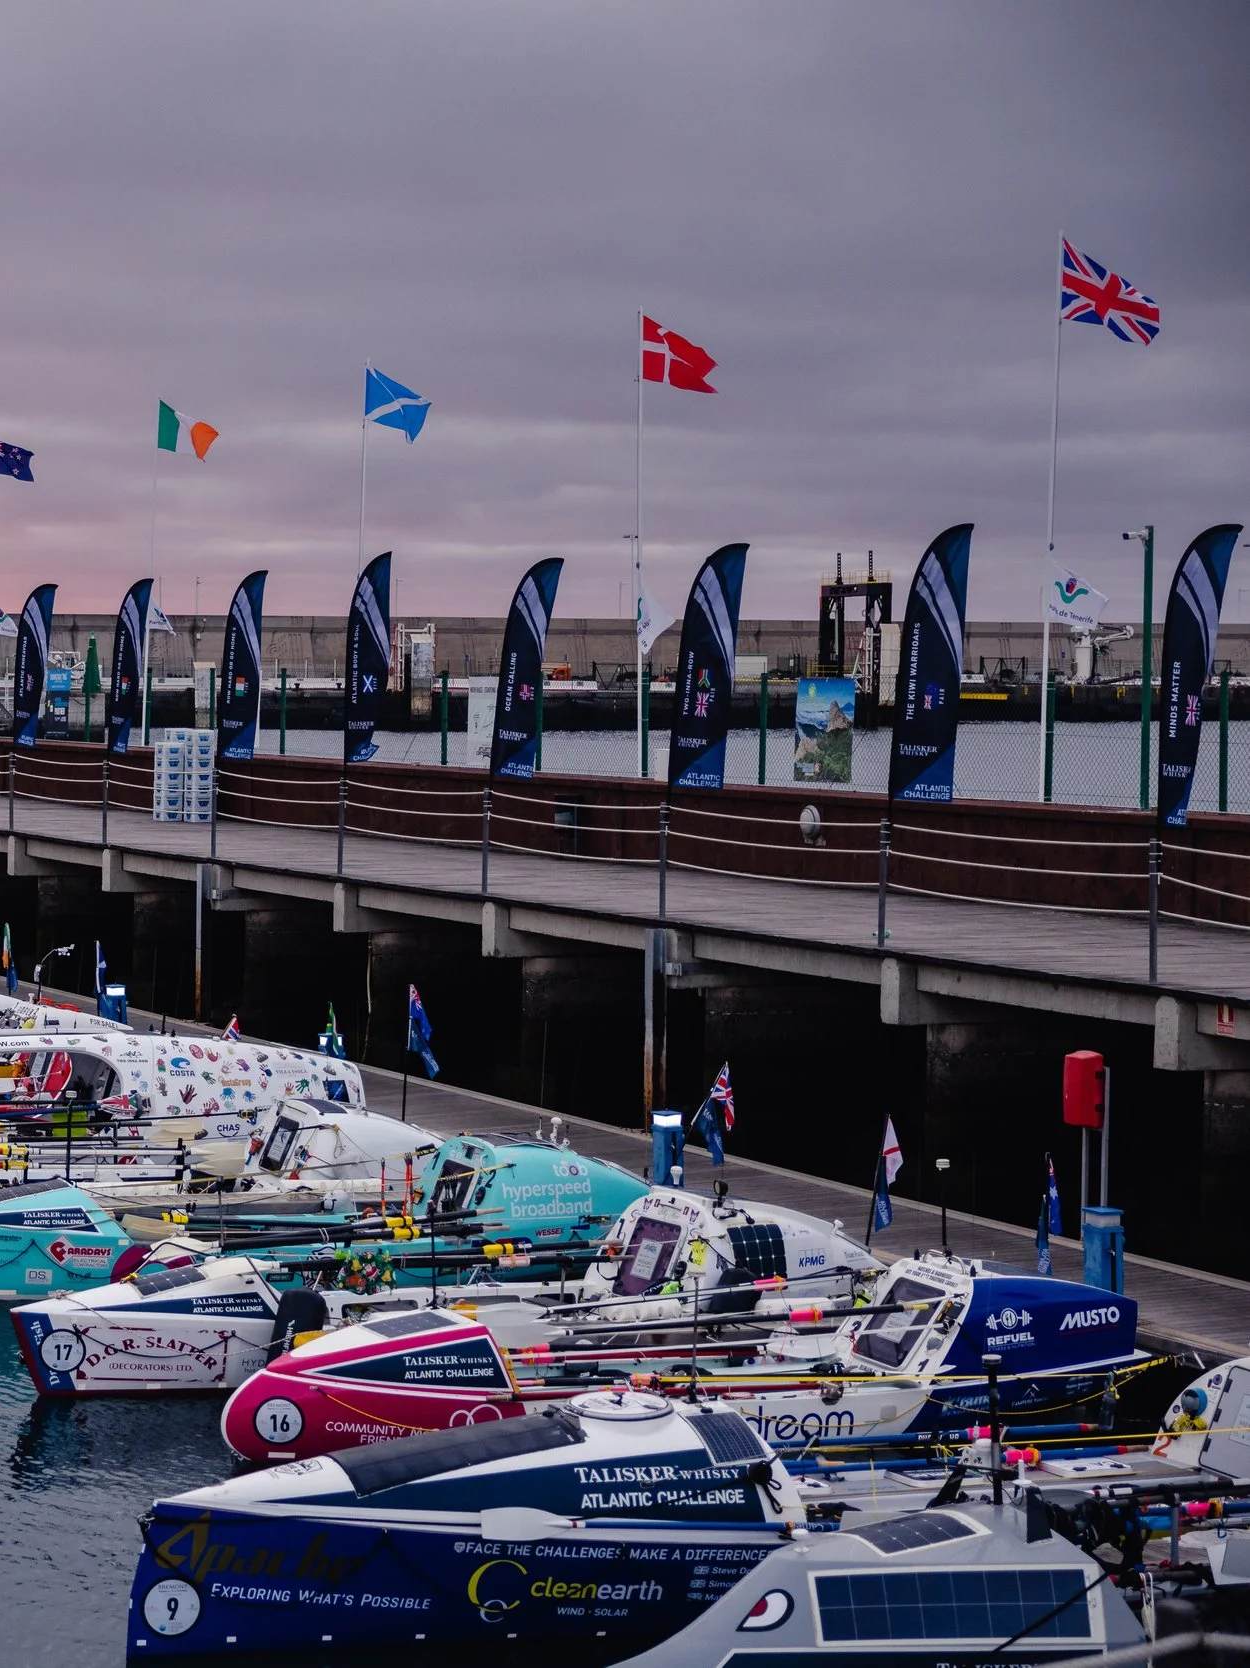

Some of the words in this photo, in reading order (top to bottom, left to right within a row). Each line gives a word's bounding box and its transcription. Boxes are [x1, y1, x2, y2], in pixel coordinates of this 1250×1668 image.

[1070, 612, 1094, 624] Tenerife
[910, 622, 921, 677] WARRIOARS
[508, 652, 517, 684] CALLING
[682, 650, 694, 716] TWO-INNA-ROW
[1172, 661, 1181, 700] MATTER
[908, 679, 916, 700] KIWI
[505, 686, 513, 712] OCEAN
[906, 703, 914, 720] THE
[1168, 704, 1178, 738] MINDS
[900, 744, 938, 752] TALISKER
[679, 778, 720, 788] CHALLENGE
[686, 772, 720, 781] ATLANTIC
[904, 790, 950, 800] CHALLENGE
[914, 783, 950, 792] ATLANTIC
[90, 1018, 100, 1026] FOR
[170, 1069, 196, 1077] COSTA
[216, 1124, 240, 1132] CHAS
[552, 1160, 588, 1177] toob
[484, 1173, 494, 1188] 2
[502, 1178, 592, 1200] hyperspeed
[510, 1198, 592, 1218] broadband
[534, 1226, 565, 1237] WESSEX
[799, 1254, 826, 1268] KPMG
[191, 1297, 235, 1305] TALISKER
[193, 1306, 224, 1314] ATLANTIC
[1060, 1306, 1120, 1331] MUSTO
[987, 1332, 1034, 1346] REFUEL
[54, 1344, 72, 1361] 17
[146, 1336, 218, 1370] SLATTER
[402, 1354, 458, 1366] TALISKER
[460, 1356, 493, 1364] WHISKY
[108, 1362, 174, 1372] (DECORATORS)
[176, 1363, 194, 1372] LTD.
[918, 1358, 930, 1372] 1
[404, 1369, 444, 1380] ATLANTIC
[446, 1368, 494, 1378] CHALLENGE
[270, 1414, 290, 1433] 16
[326, 1422, 406, 1436] COMMUNITY
[746, 1406, 854, 1440] dream
[1152, 1434, 1172, 1458] 2
[574, 1466, 676, 1484] TALISKER
[680, 1468, 740, 1481] WHISKY
[581, 1490, 653, 1510] ATLANTIC
[657, 1488, 746, 1506] CHALLENGE
[466, 1542, 501, 1555] FACE
[506, 1544, 532, 1556] THE
[629, 1548, 668, 1560] MAKE
[672, 1549, 681, 1560] A
[712, 1566, 737, 1574] Steve
[158, 1583, 188, 1591] BREMONT
[530, 1576, 663, 1600] cleanearth
[211, 1583, 291, 1604] EXPLORING
[299, 1590, 354, 1606] WHAT'S
[360, 1594, 432, 1610] POSSIBLE
[166, 1598, 180, 1621] 9
[556, 1606, 585, 1616] WIND
[594, 1608, 629, 1617] SOLAR
